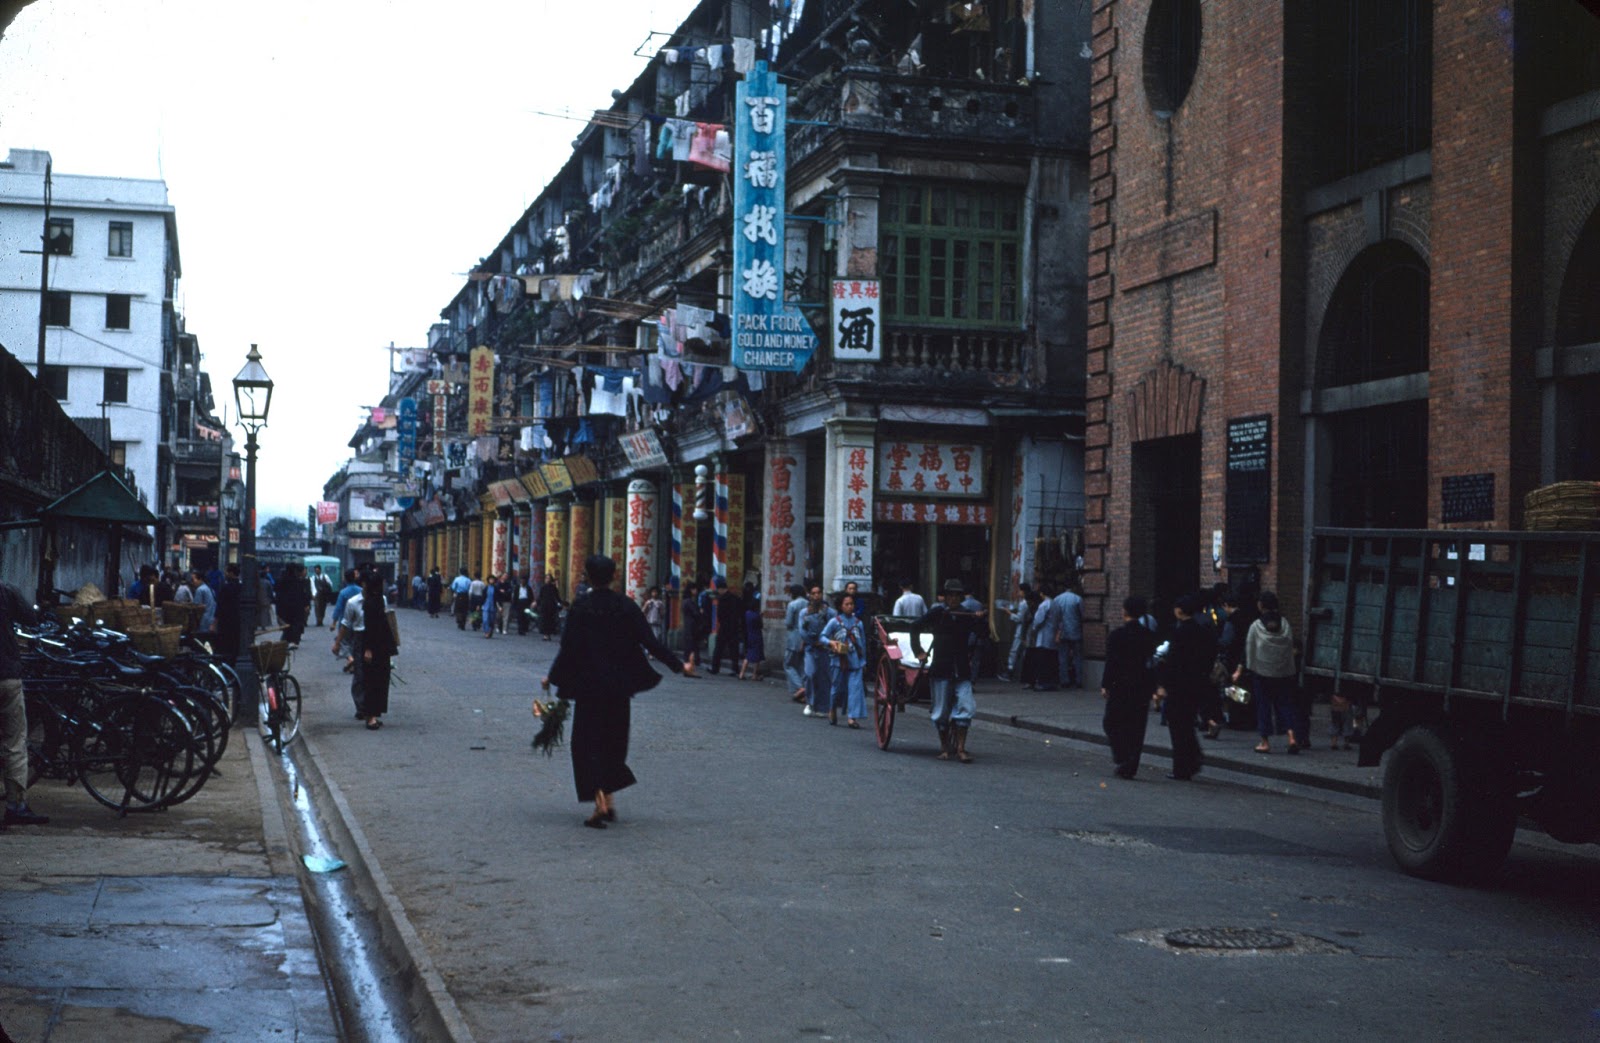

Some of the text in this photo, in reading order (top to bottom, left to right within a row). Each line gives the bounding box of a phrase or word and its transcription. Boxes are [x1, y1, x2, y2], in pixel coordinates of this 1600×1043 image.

[743, 96, 780, 300] 百福找換
[737, 314, 803, 332] PACK FOOK
[838, 306, 875, 352] 酒
[737, 333, 815, 350] GOLD AND MONEY
[743, 351, 795, 367] CHANGER
[886, 443, 976, 473] 百福堂
[847, 448, 869, 520] 得華隆
[842, 521, 873, 533] FISHING
[265, 542, 307, 550] ARCAD
[629, 494, 654, 588] 郭興隆
[846, 536, 868, 547] LINE
[854, 550, 862, 561] &
[842, 565, 872, 577] HOOKS
